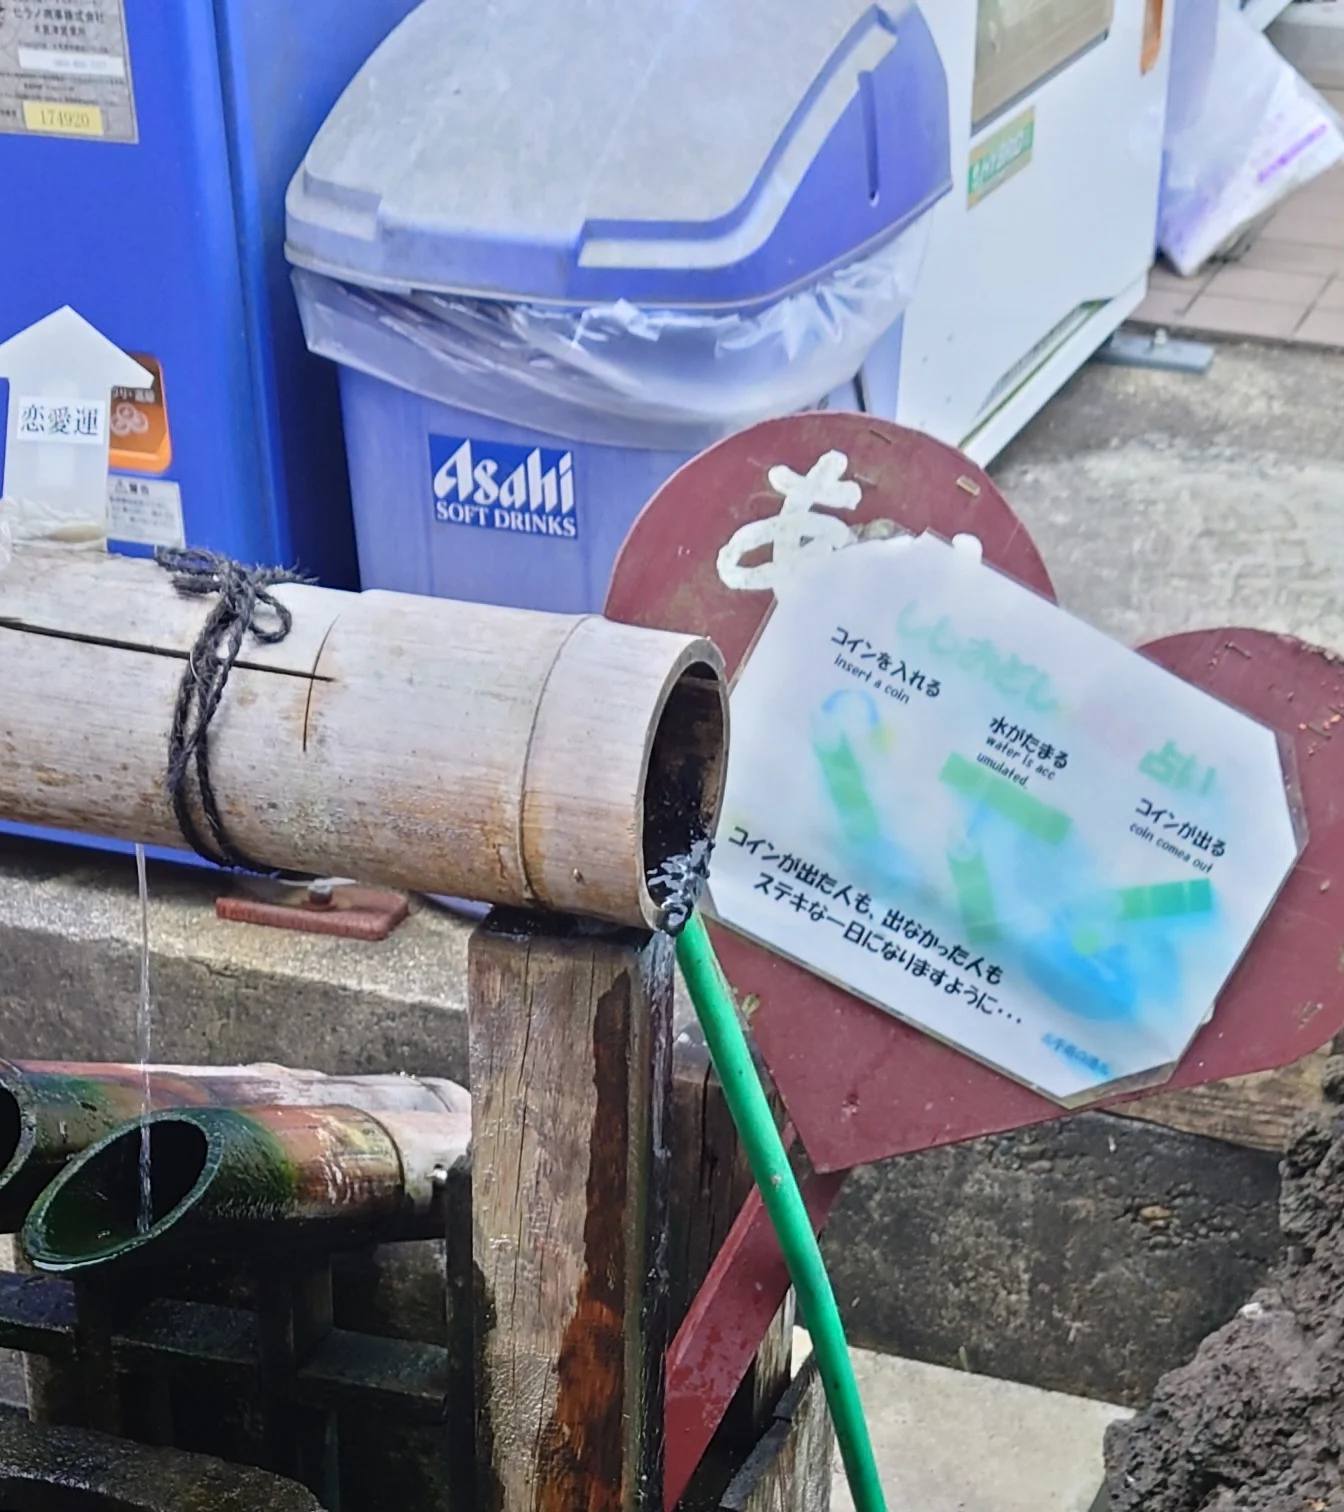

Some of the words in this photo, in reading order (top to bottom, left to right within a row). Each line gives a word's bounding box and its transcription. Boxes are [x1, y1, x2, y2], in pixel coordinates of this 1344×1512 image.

[40, 109, 90, 129] 174920
[21, 403, 99, 436] 恋愛運
[433, 438, 575, 515] Asahi
[436, 500, 489, 527] SOFT
[494, 508, 576, 538] DRINKS
[831, 625, 942, 698] コインを入れる
[834, 653, 874, 683] insert
[884, 682, 910, 705] coin
[985, 735, 1021, 760] water
[1035, 763, 1057, 781] acc
[989, 715, 1070, 770] 水がたまる
[1129, 821, 1155, 843] coin
[1192, 857, 1215, 874] out
[1135, 797, 1228, 858] コインが出る
[728, 825, 1003, 987] コインが出た人も、出なかった人も
